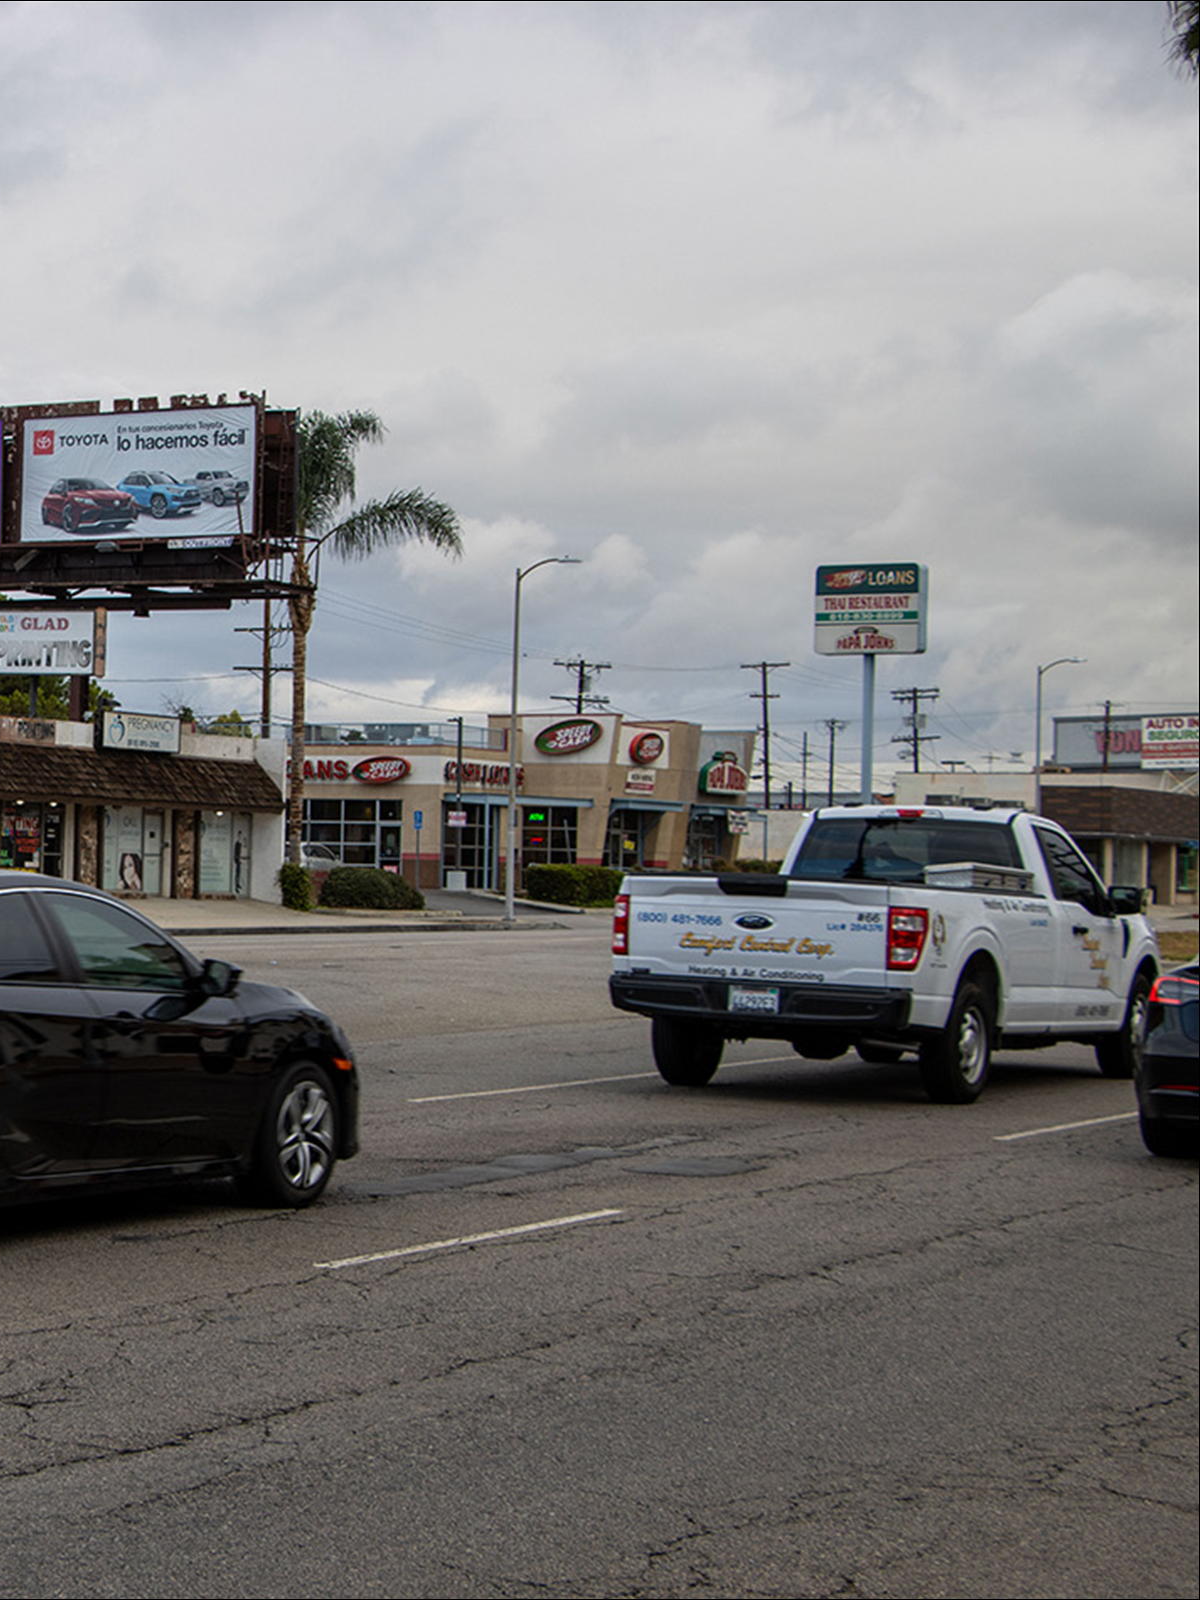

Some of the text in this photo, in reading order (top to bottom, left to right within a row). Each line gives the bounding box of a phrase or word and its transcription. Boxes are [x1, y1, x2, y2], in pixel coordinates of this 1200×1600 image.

[199, 421, 224, 431] Toyota
[59, 434, 109, 448] TOYOTA
[117, 428, 246, 451] lo hacemos fácil
[868, 570, 916, 586] LOANS
[824, 596, 910, 611] THAI RESTAURANT
[20, 617, 70, 631] GLAD
[837, 635, 862, 650] PAPA
[128, 717, 175, 733] PREGNANCY
[1146, 718, 1185, 729] AUTO
[637, 911, 723, 927] (800) 481-7666
[857, 912, 881, 924] #66
[689, 965, 825, 983] Heating & Air Conditioning
